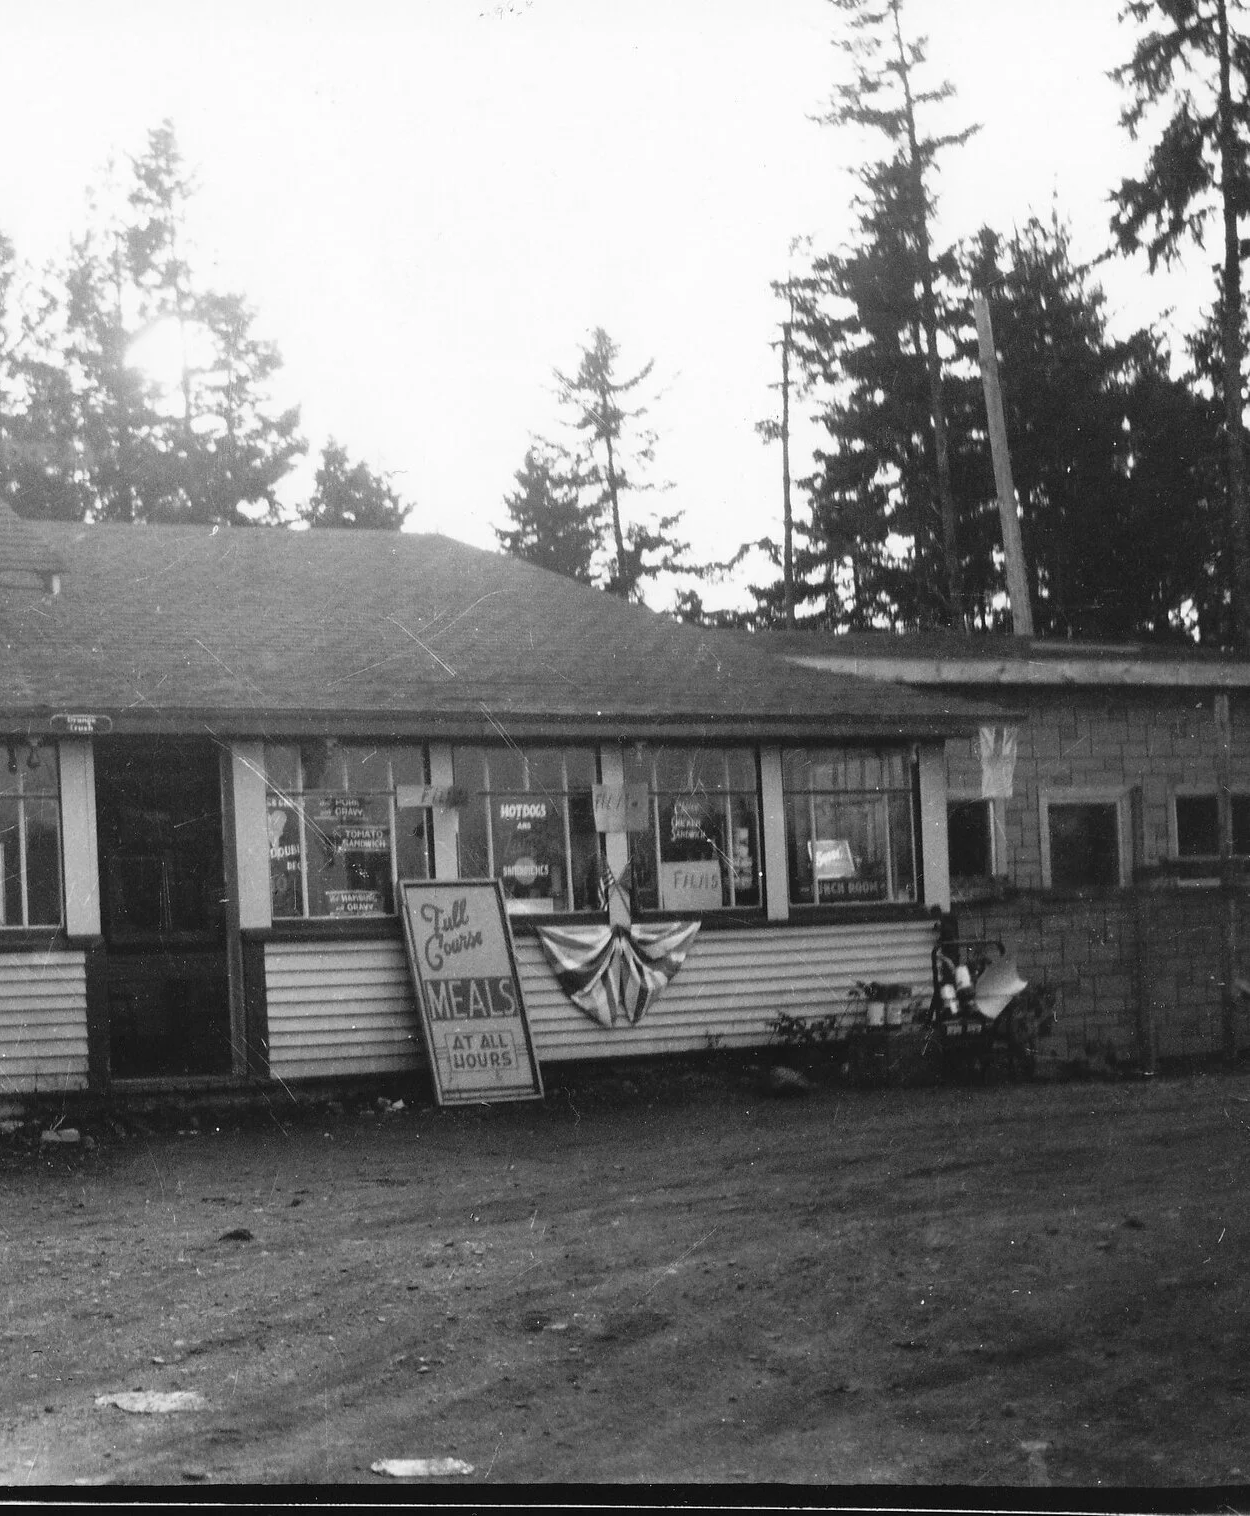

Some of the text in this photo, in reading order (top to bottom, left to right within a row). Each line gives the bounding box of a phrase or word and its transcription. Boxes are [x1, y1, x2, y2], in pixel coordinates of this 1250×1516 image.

[345, 829, 384, 839] TOMATO
[341, 839, 386, 849] SANDWICH
[420, 897, 470, 938] Full
[424, 931, 483, 971] Course
[426, 978, 517, 1020] MEALS
[452, 1033, 509, 1050] AT ALL
[453, 1052, 513, 1070] HOURS
